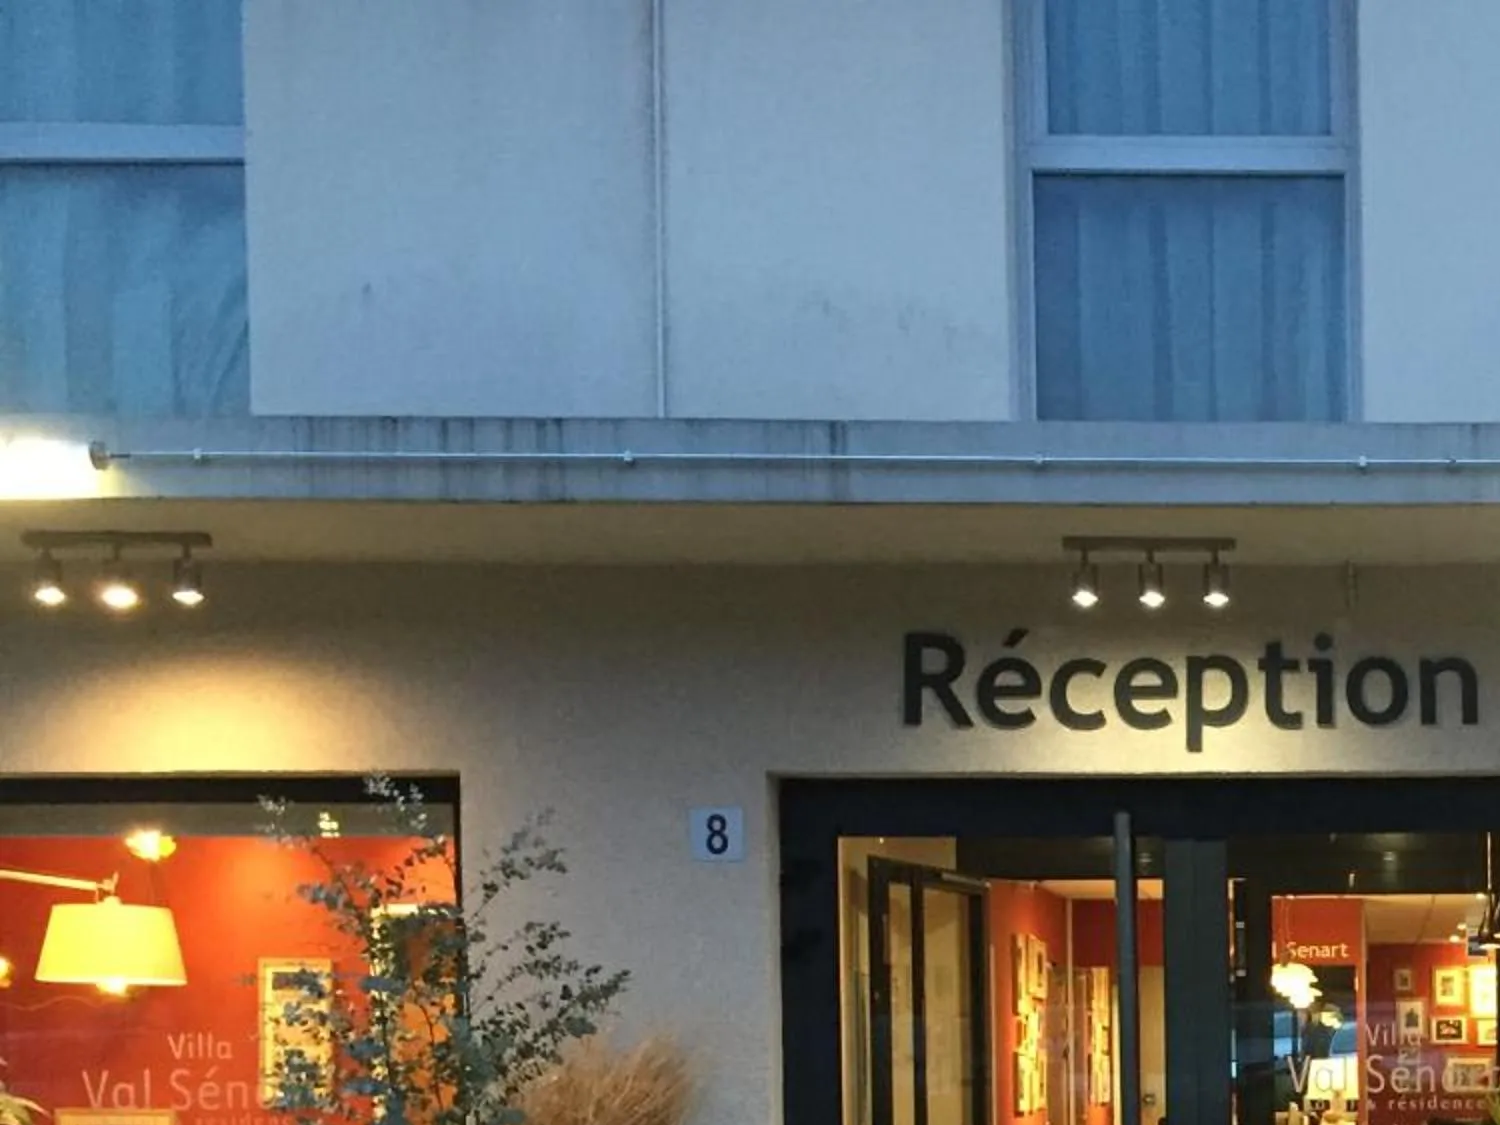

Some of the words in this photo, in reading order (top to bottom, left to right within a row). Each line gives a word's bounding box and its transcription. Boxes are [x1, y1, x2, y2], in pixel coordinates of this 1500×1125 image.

[902, 628, 1479, 753] Réception
[706, 814, 729, 855] 8
[167, 1033, 233, 1060] Villa
[1365, 1022, 1422, 1047] Villa
[82, 1068, 151, 1110] Val
[1287, 1054, 1348, 1095] Val
[1388, 1097, 1486, 1111] résidence
